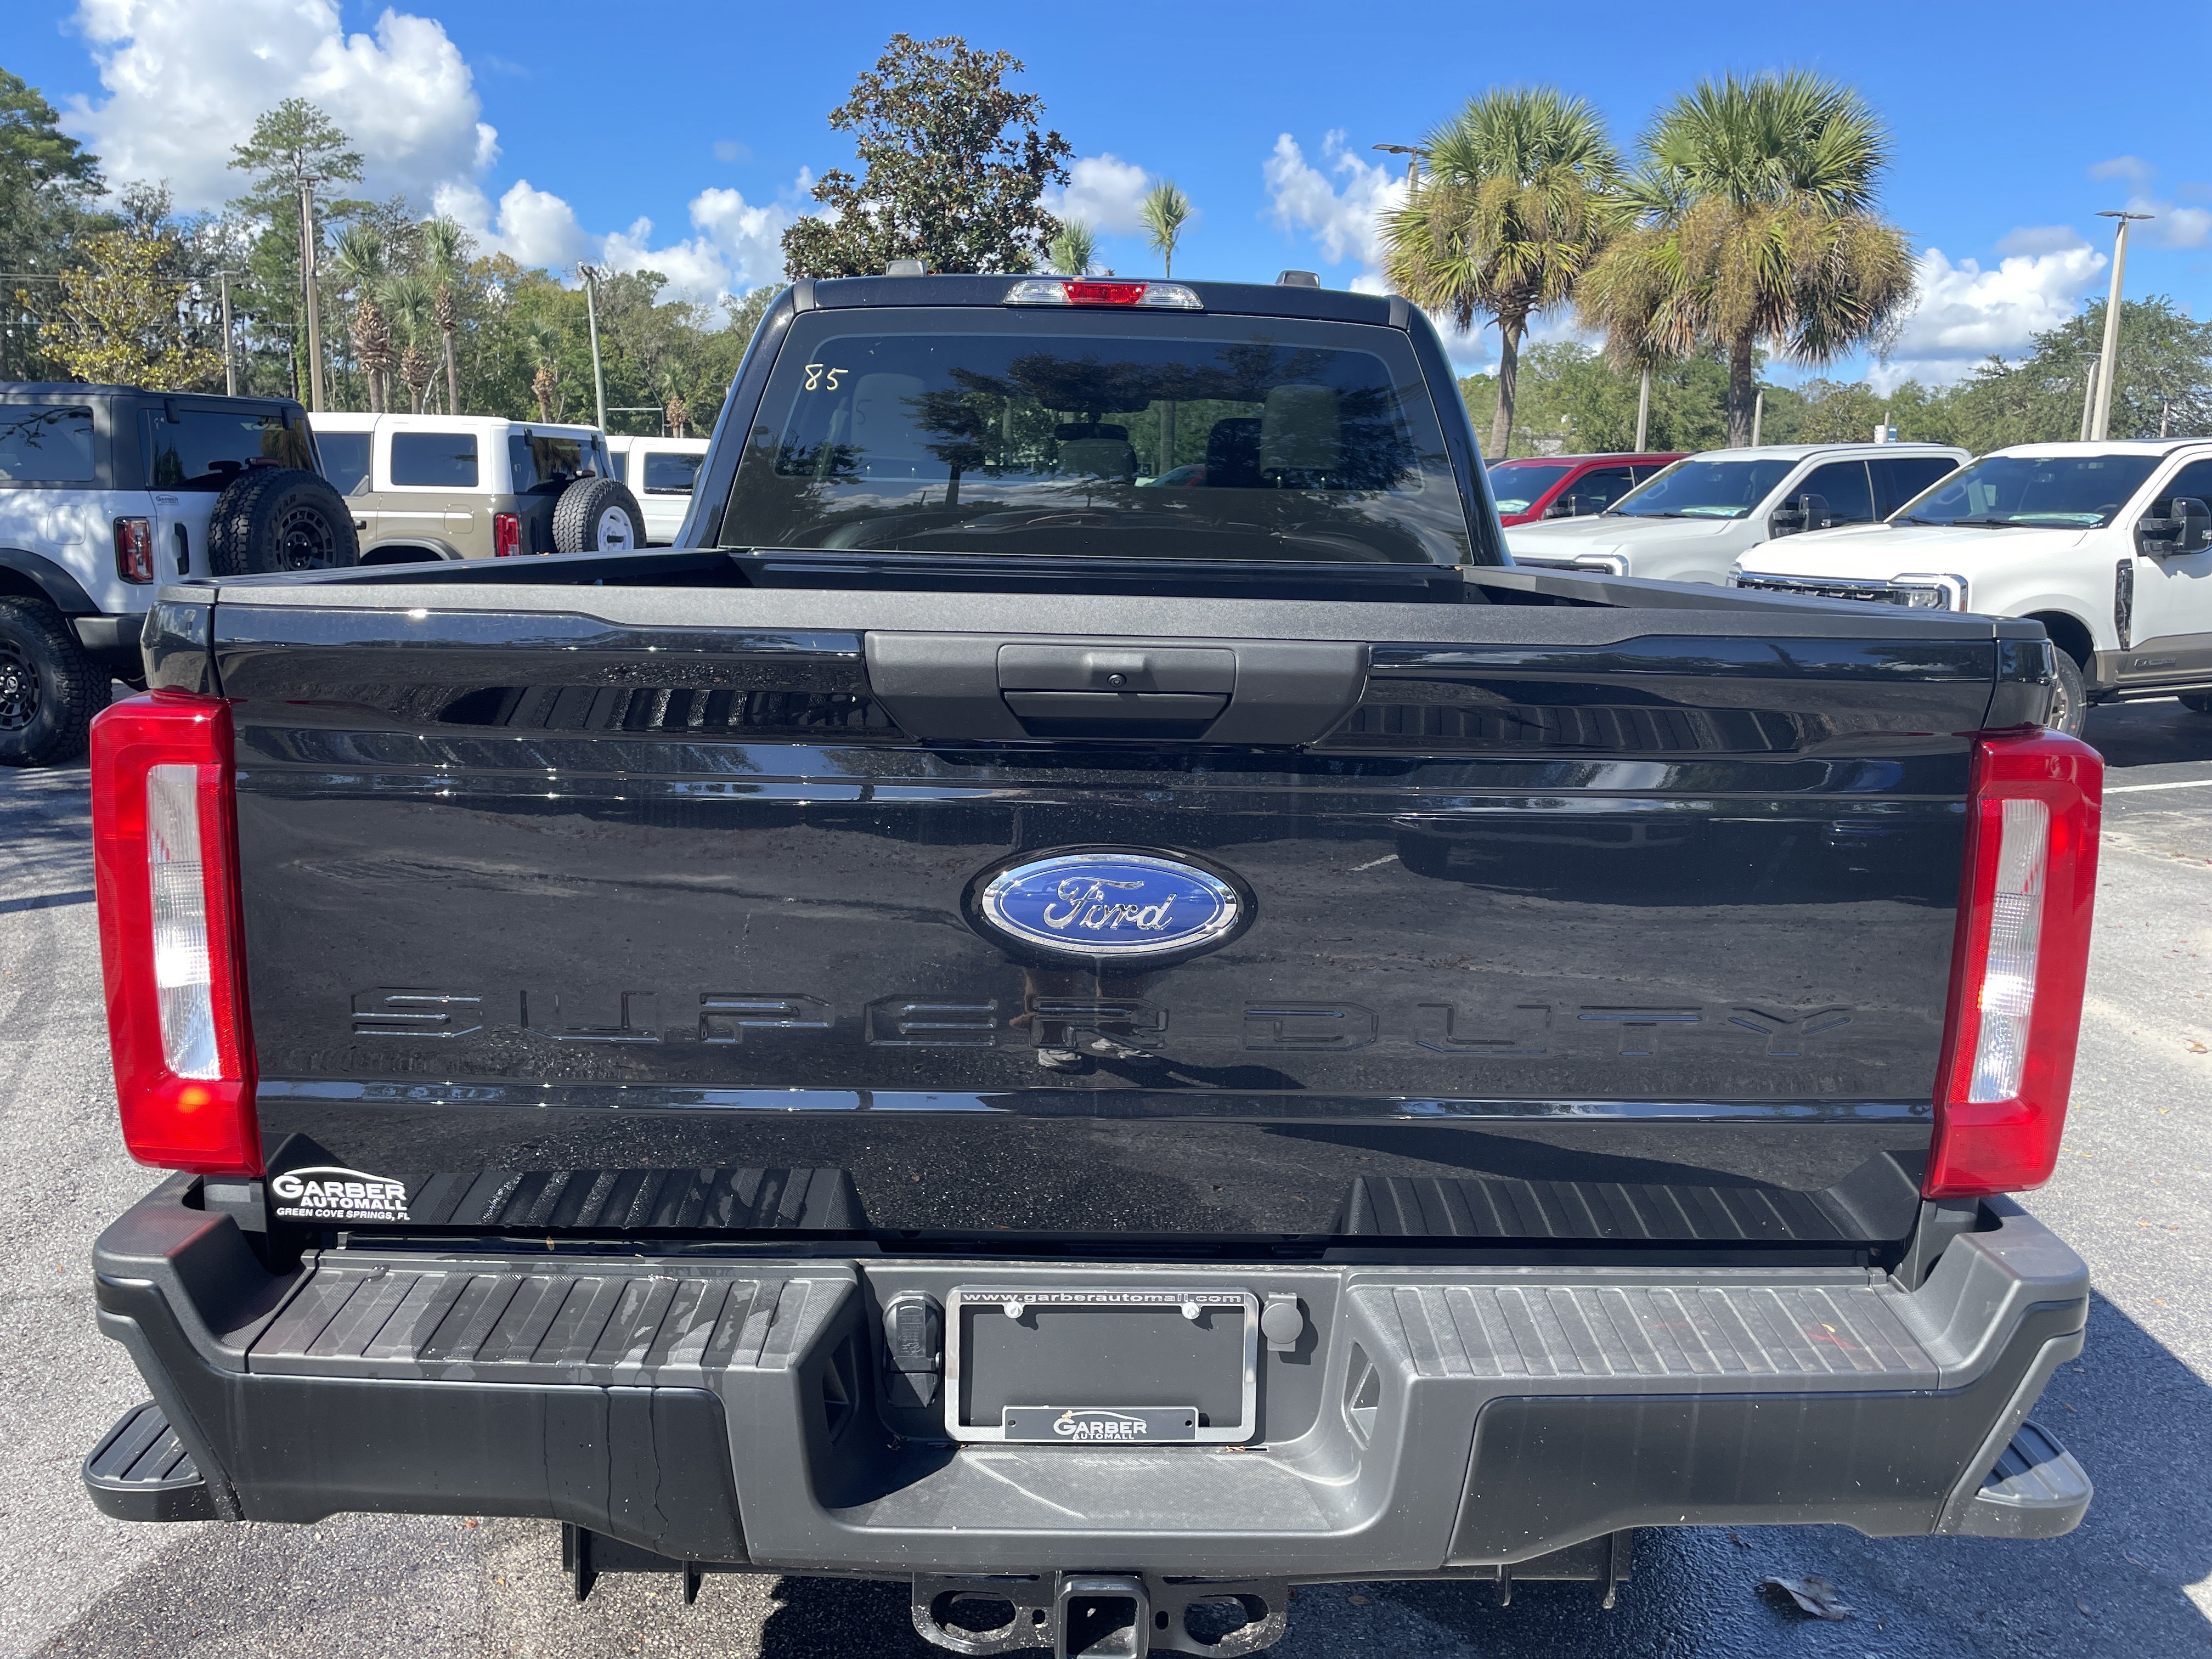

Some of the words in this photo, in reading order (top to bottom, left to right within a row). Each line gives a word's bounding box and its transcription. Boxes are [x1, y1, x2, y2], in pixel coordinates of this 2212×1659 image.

[805, 363, 849, 391] 85
[1043, 876, 1177, 930] Ford
[351, 989, 1169, 1048] SUPER
[1243, 998, 1852, 1057] DUTY
[272, 1175, 407, 1200] GARBER
[300, 1196, 407, 1210] AUTOMALL
[276, 1207, 313, 1216] GREEN
[315, 1209, 343, 1218] COVE
[346, 1210, 396, 1221] SPRINGS,
[397, 1212, 410, 1220] FL
[962, 1293, 1242, 1303] www.garberautomall.com
[1053, 1418, 1147, 1435] GARBER
